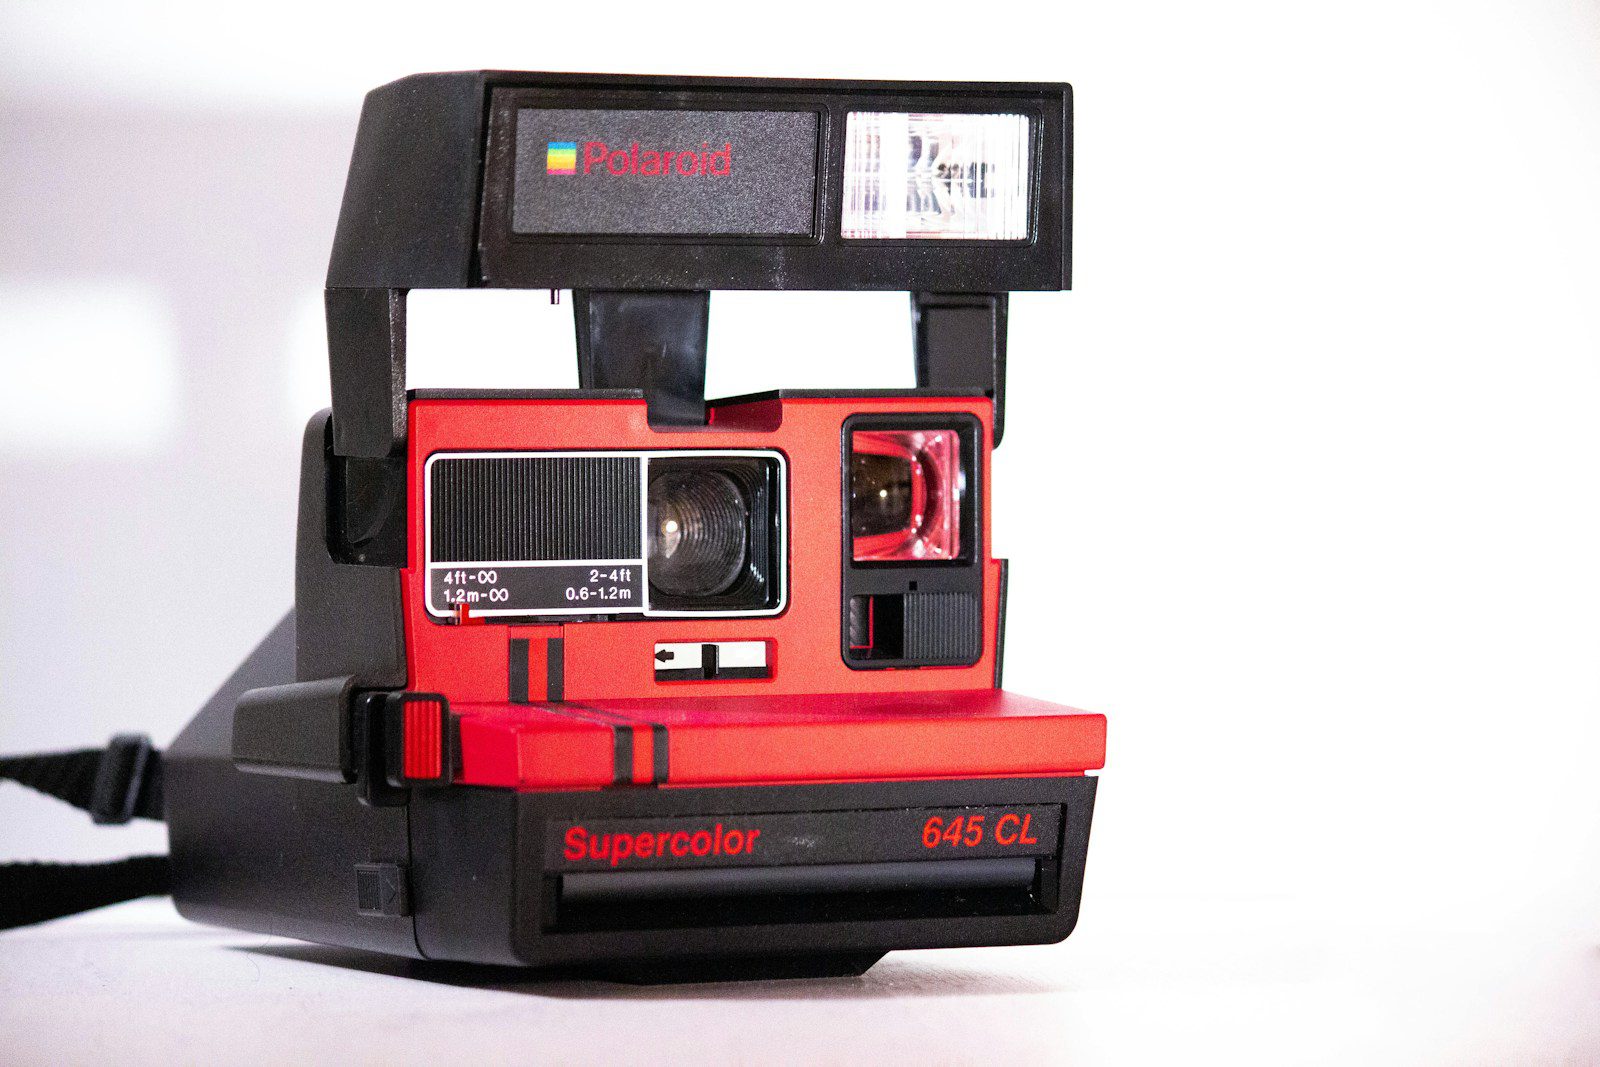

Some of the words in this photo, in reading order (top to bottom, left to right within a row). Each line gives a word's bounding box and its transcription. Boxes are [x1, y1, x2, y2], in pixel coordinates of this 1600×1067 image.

[584, 142, 732, 177] Polaroid
[589, 568, 632, 583] 2-4ft
[565, 587, 632, 601] 0.6-1.2m
[564, 823, 761, 867] Supercolor
[922, 814, 985, 849] 645
[993, 813, 1038, 847] CL
